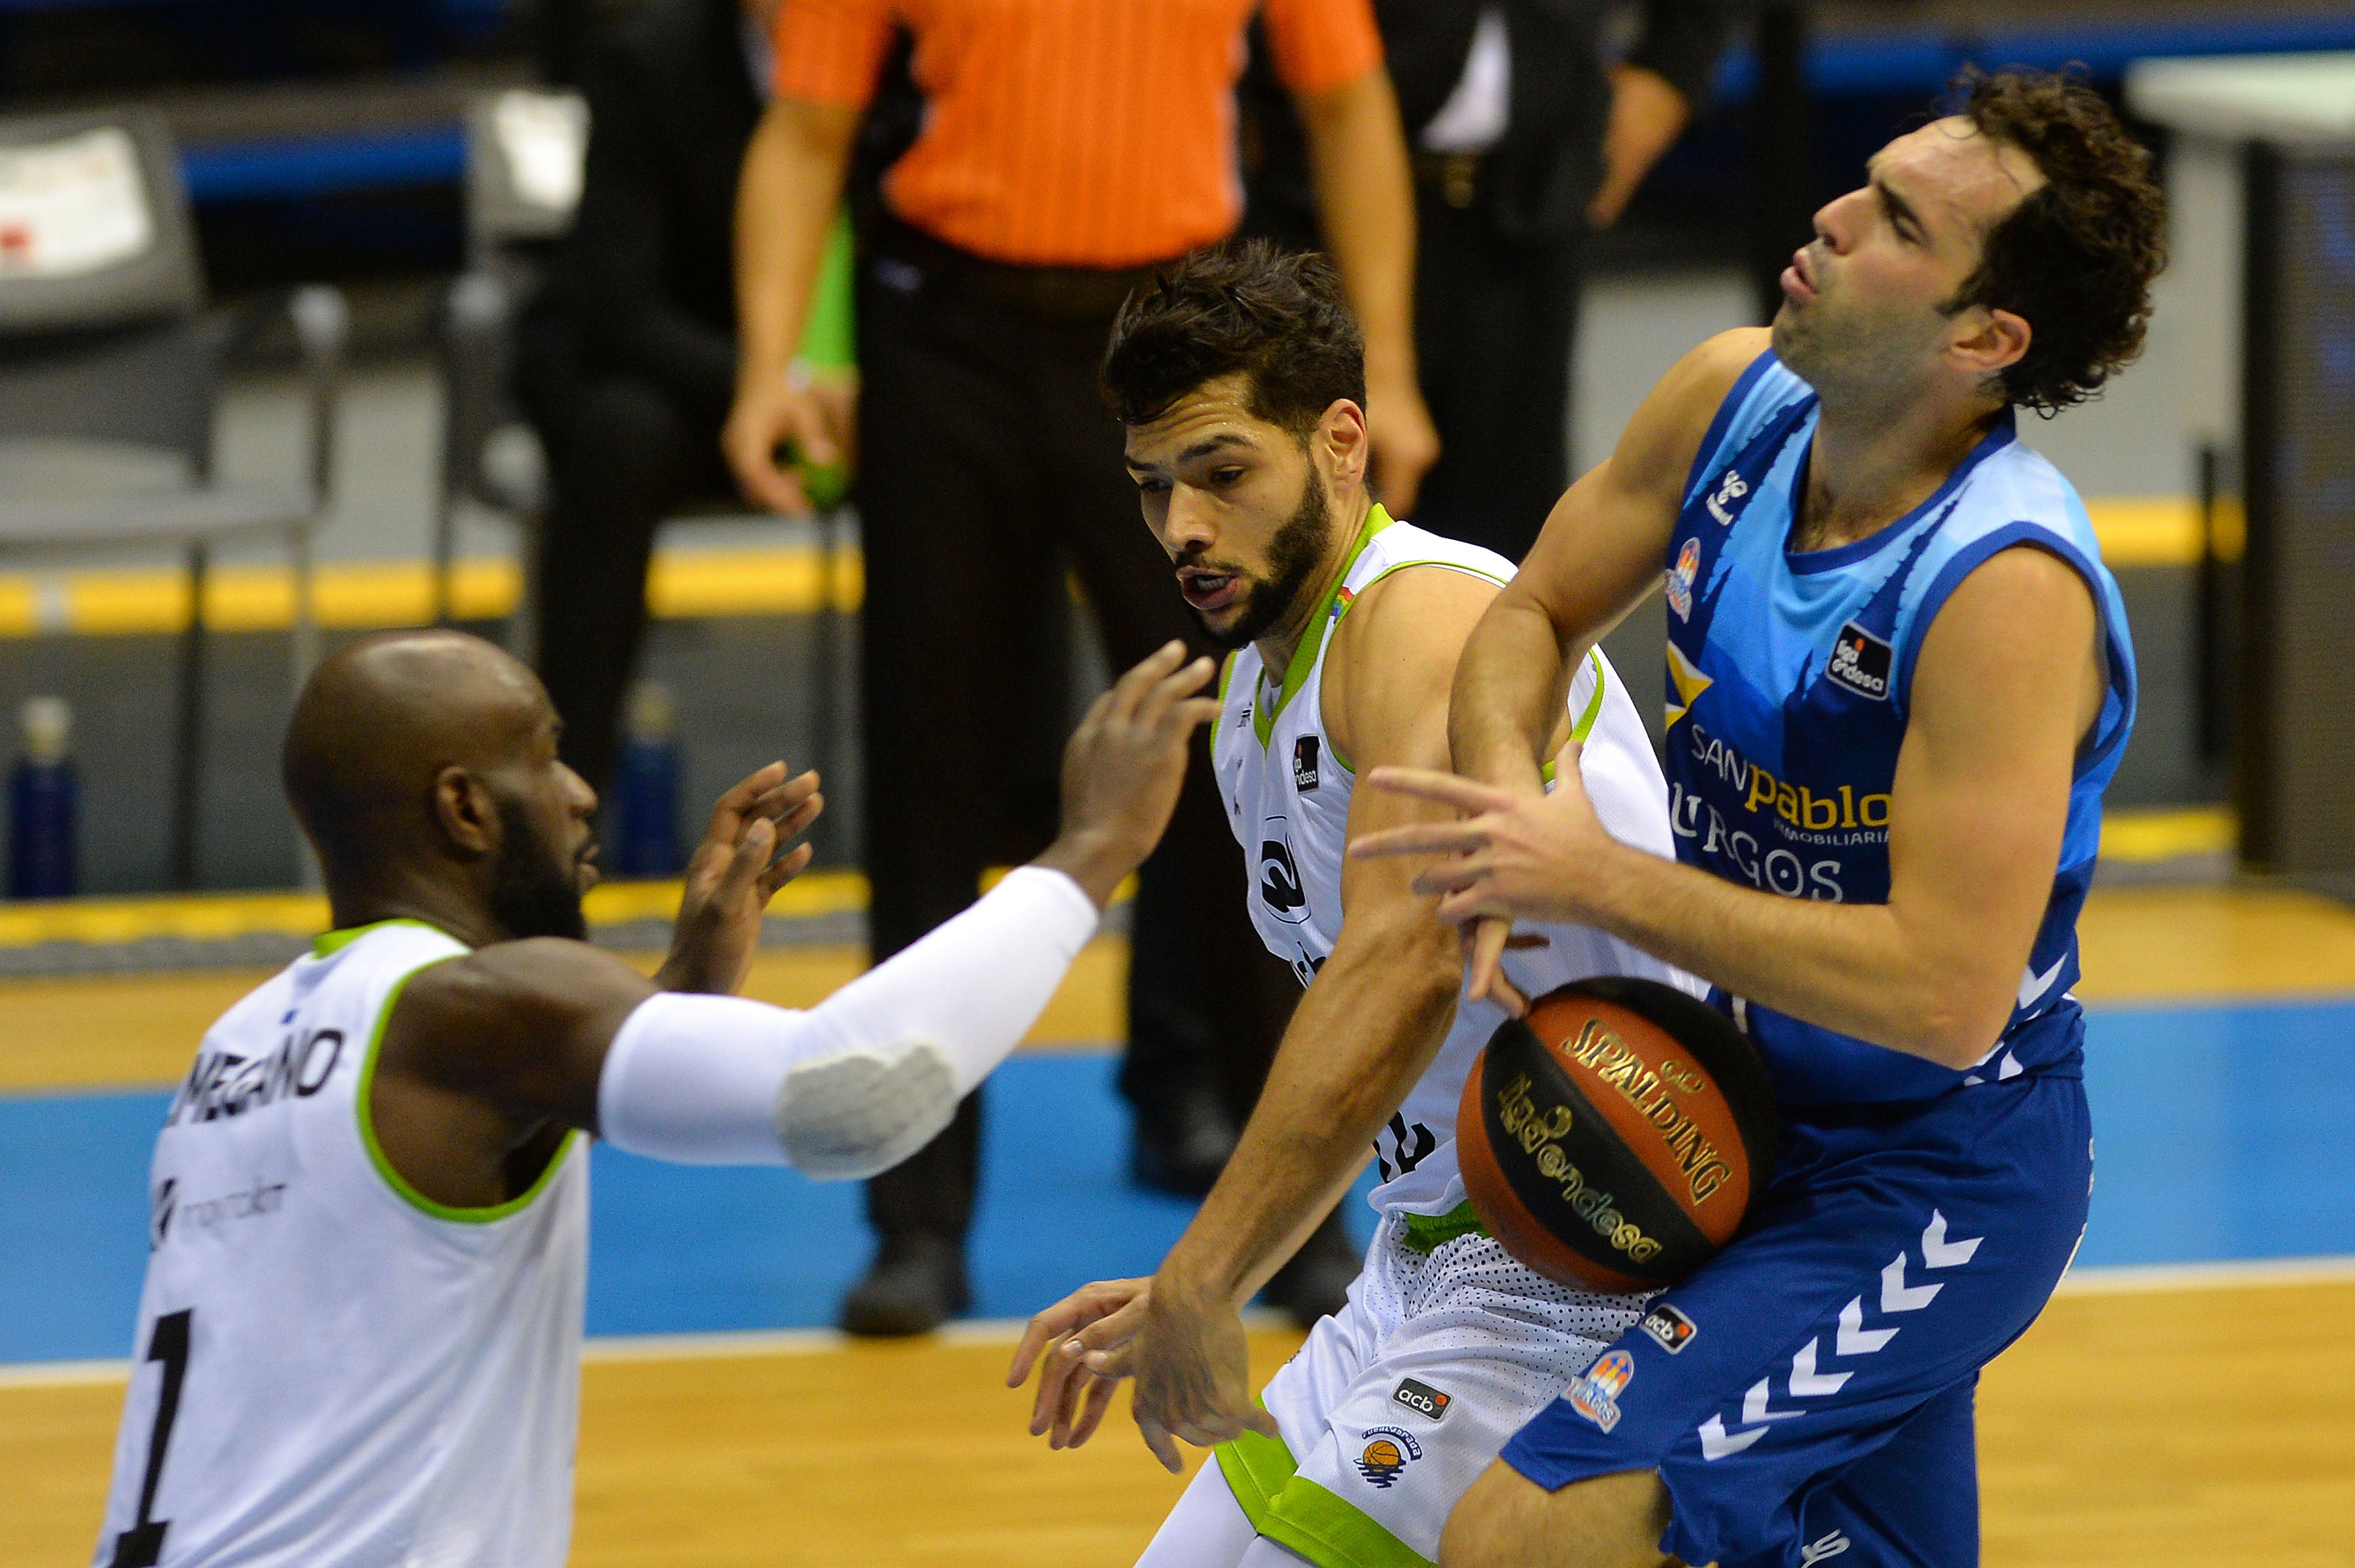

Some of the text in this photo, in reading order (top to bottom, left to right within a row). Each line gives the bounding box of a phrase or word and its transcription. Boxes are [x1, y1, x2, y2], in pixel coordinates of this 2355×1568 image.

[1560, 1017, 1733, 1206] SPALDING
[1645, 1314, 1673, 1340] acb
[1398, 1389, 1435, 1412] acb
